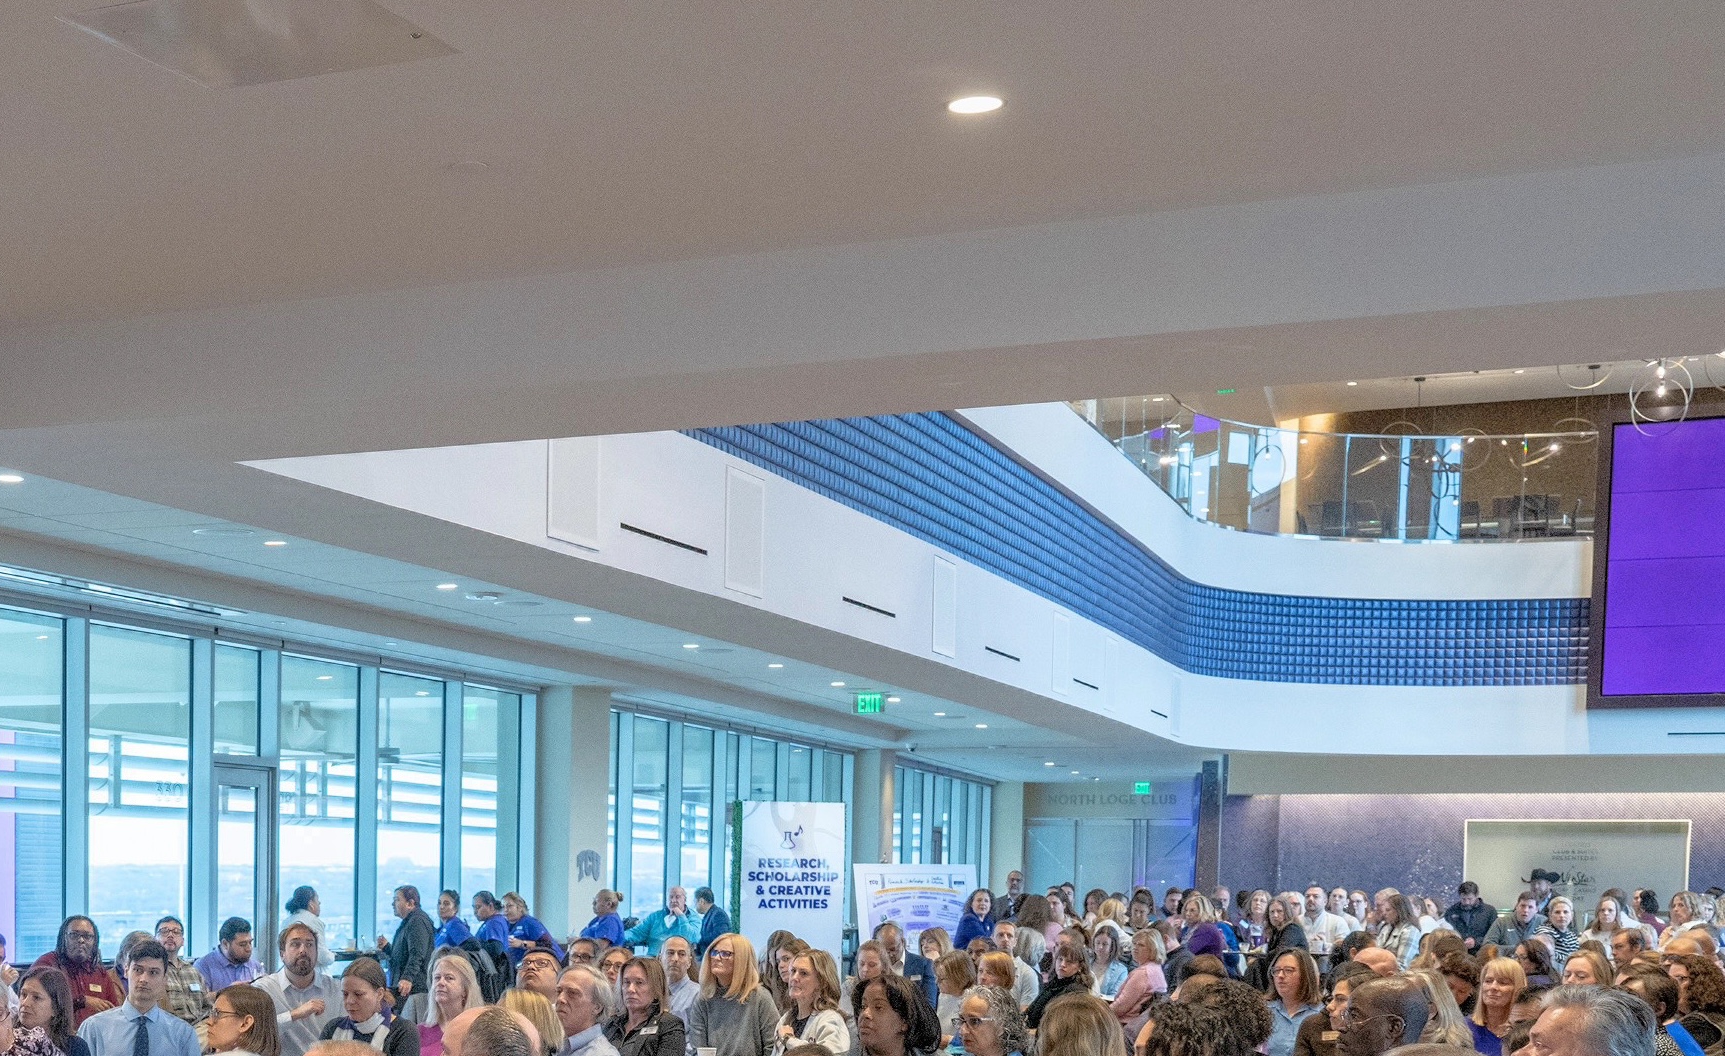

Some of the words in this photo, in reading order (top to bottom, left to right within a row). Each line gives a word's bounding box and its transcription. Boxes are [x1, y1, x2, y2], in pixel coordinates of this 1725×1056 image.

[857, 693, 881, 713] EXIT
[1142, 794, 1177, 805] CLUB
[758, 858, 829, 870] RESEARCH,
[748, 871, 839, 882] SCHOLARSHIP
[756, 885, 765, 896] &
[769, 885, 831, 896] CREATIVE
[758, 899, 828, 909] ACTIVITIES
